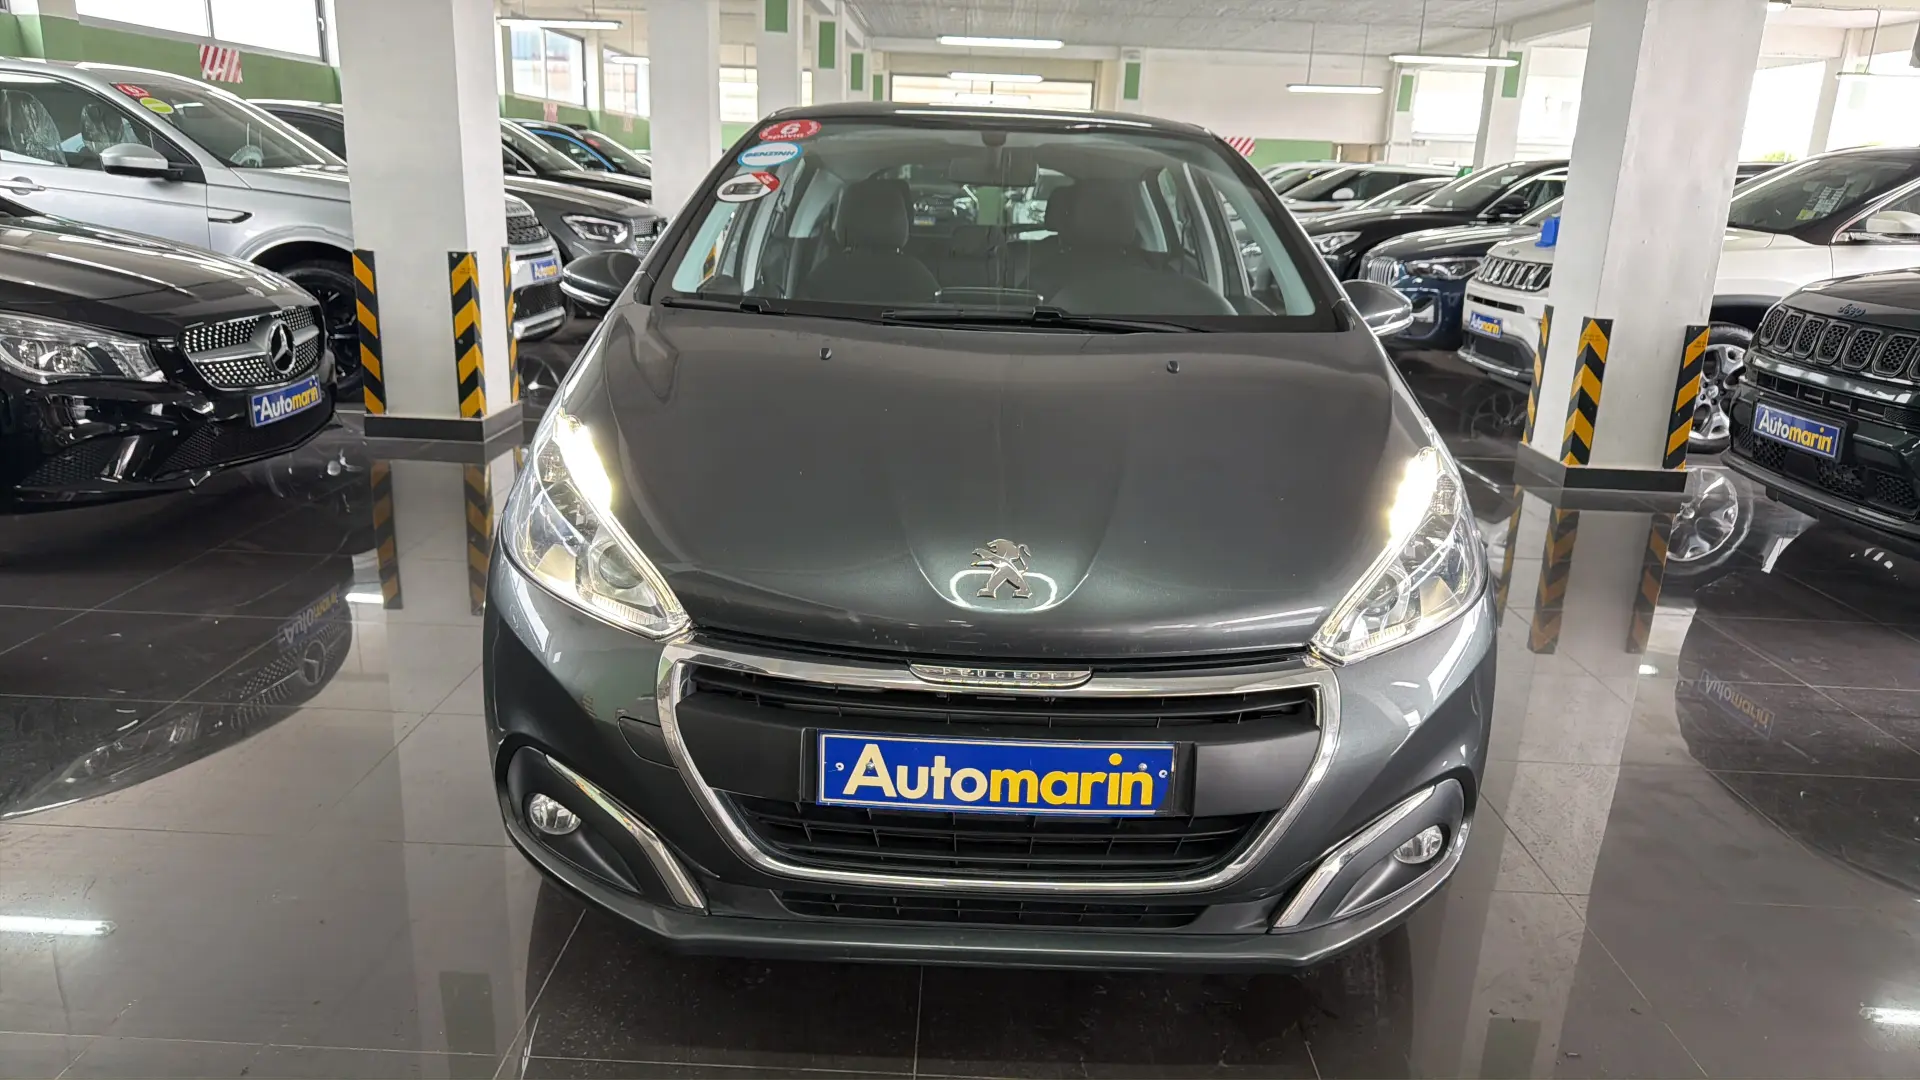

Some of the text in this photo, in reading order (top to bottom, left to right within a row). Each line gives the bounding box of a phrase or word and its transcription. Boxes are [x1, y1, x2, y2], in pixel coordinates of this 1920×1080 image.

[261, 382, 319, 421] Automarin
[1758, 409, 1833, 453] Automarin
[943, 667, 1057, 680] PEUGEOT
[842, 743, 1154, 806] Automarin
